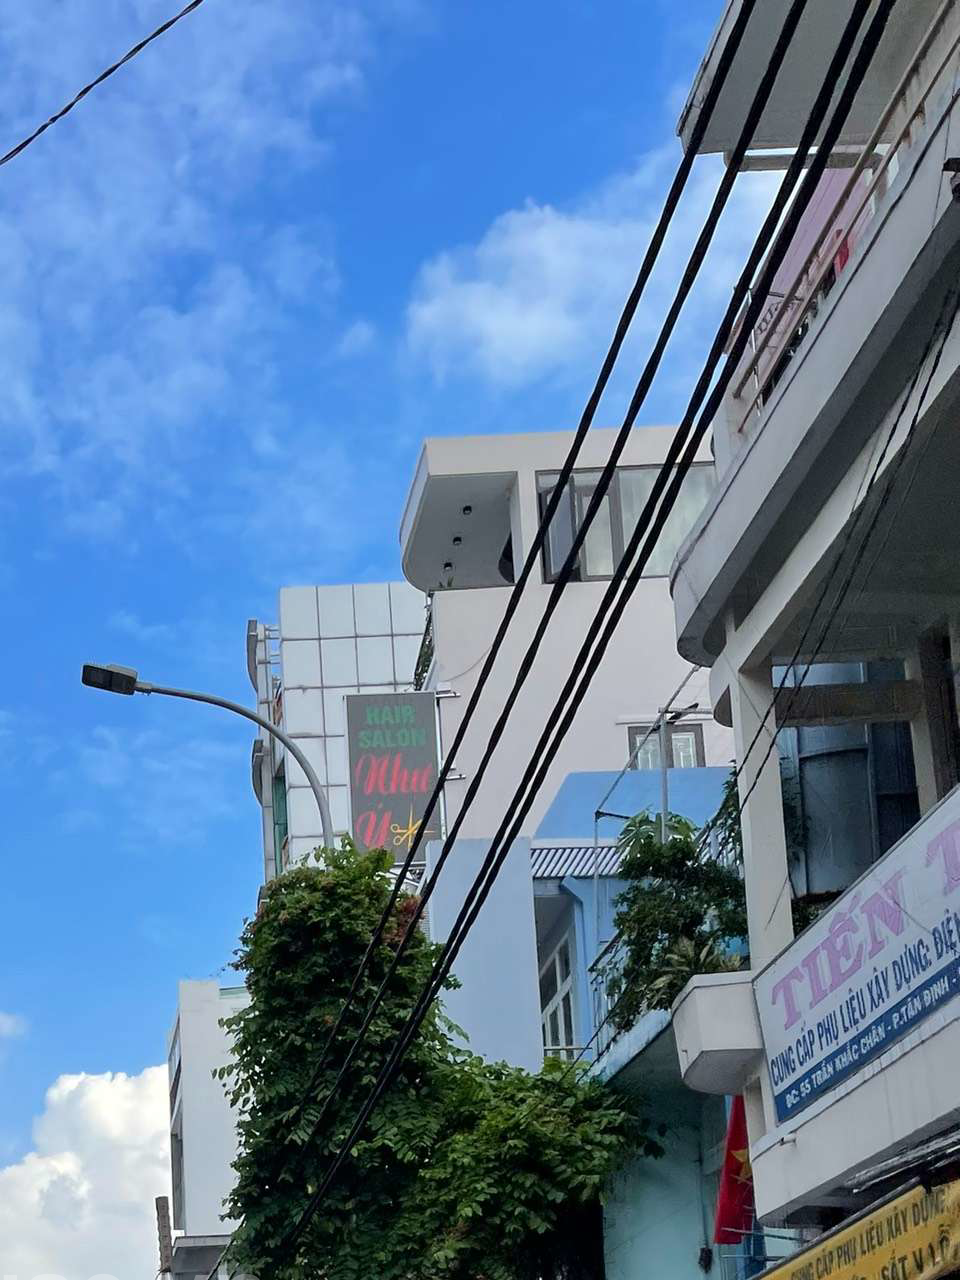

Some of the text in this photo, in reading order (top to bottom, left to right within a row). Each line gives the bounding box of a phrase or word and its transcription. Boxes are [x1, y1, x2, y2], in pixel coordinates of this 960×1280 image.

[366, 705, 416, 725] HAIR
[358, 728, 426, 749] SALON
[771, 865, 908, 1031] TIẾN
[771, 1045, 797, 1087] CUNG
[796, 1020, 816, 1067] CẤP
[817, 1010, 840, 1052] PHỤ
[840, 987, 867, 1033] LIỆU
[867, 966, 890, 1013] XÂY
[860, 1023, 886, 1054] CHÂN
